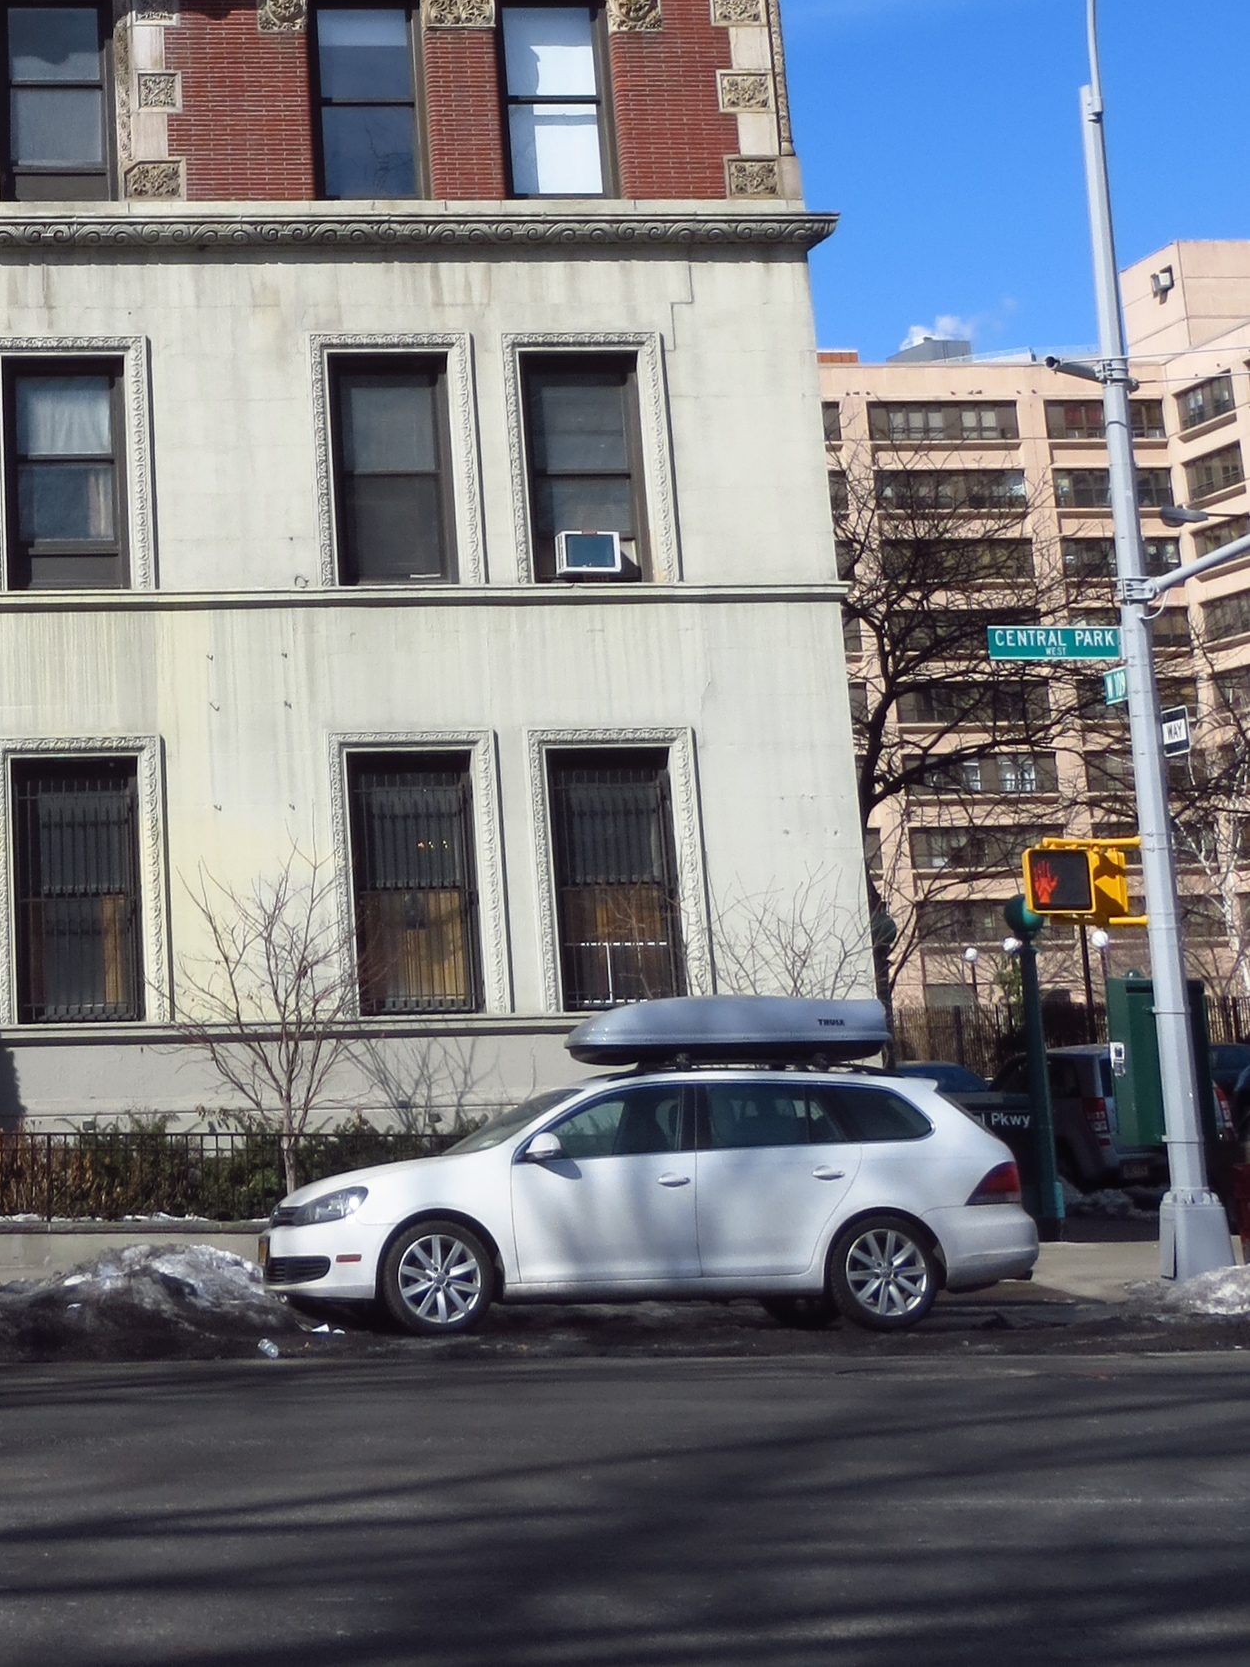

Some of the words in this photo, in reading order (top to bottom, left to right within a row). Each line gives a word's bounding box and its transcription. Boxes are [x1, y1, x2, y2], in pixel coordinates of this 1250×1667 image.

[994, 630, 1067, 647] CENTRAL
[1074, 630, 1116, 647] PARK
[1045, 647, 1067, 656] WEST
[1166, 721, 1183, 741] WAY
[817, 1018, 846, 1027] THULE
[990, 1112, 1031, 1129] Pkwy
